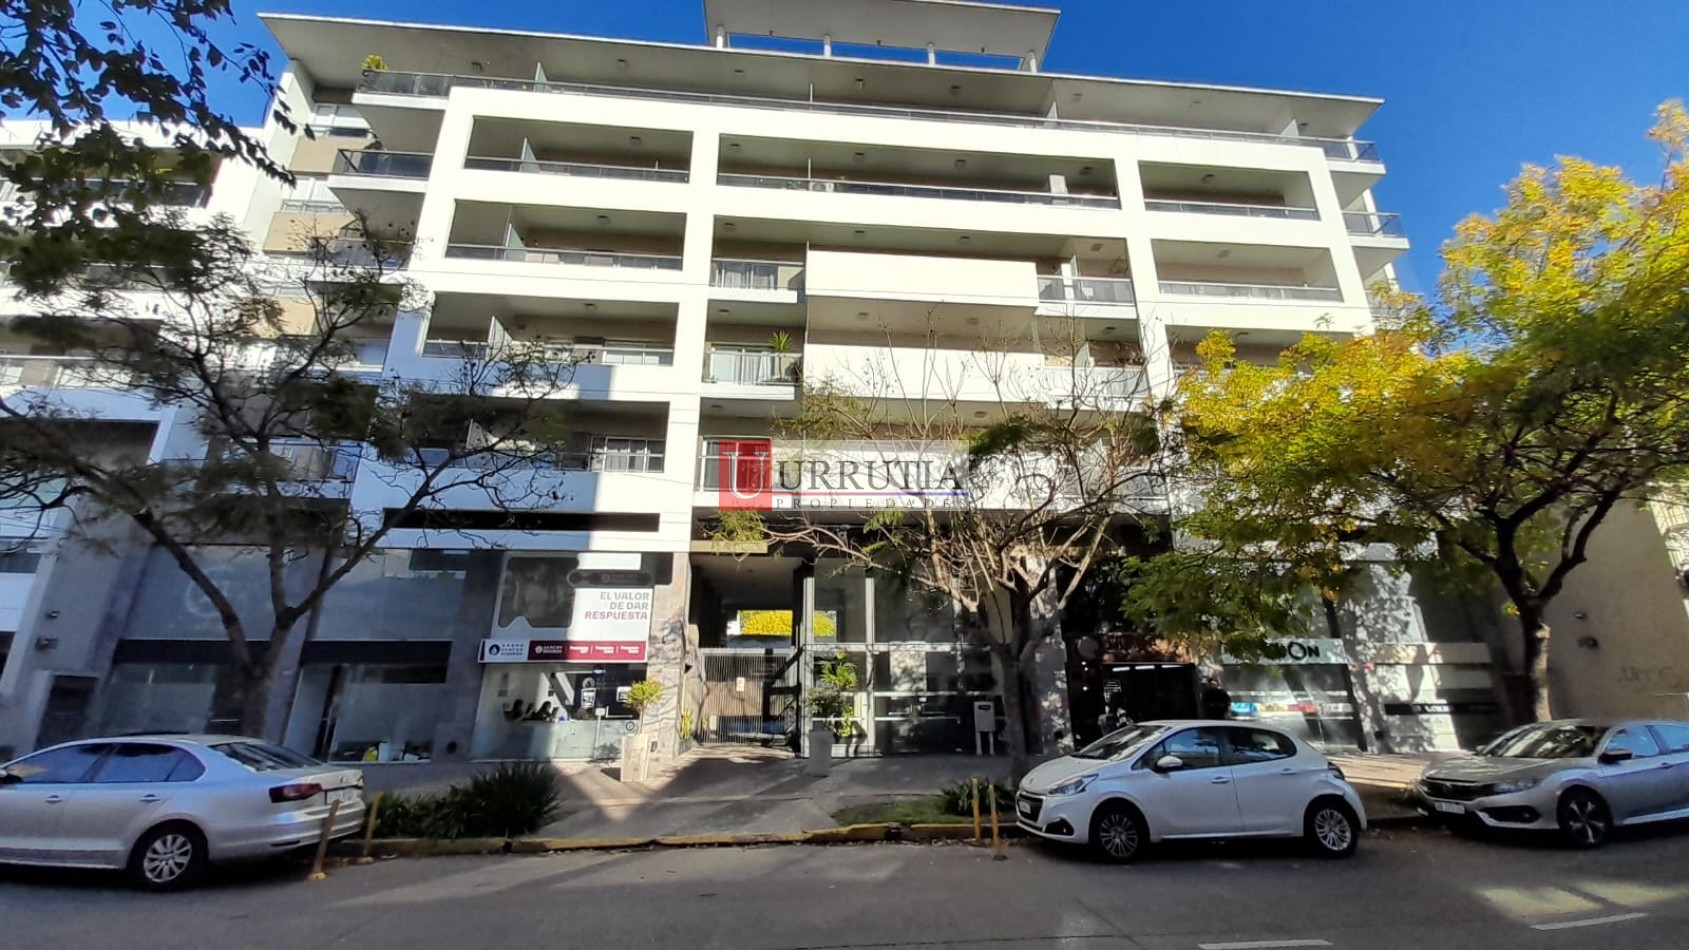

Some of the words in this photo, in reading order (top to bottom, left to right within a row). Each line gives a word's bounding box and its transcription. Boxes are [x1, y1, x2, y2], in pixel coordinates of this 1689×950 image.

[600, 591, 612, 600] EL
[614, 591, 649, 600] VALOR
[609, 601, 623, 610] DE
[626, 601, 648, 610] DAR
[585, 611, 648, 620] RESPUESTA
